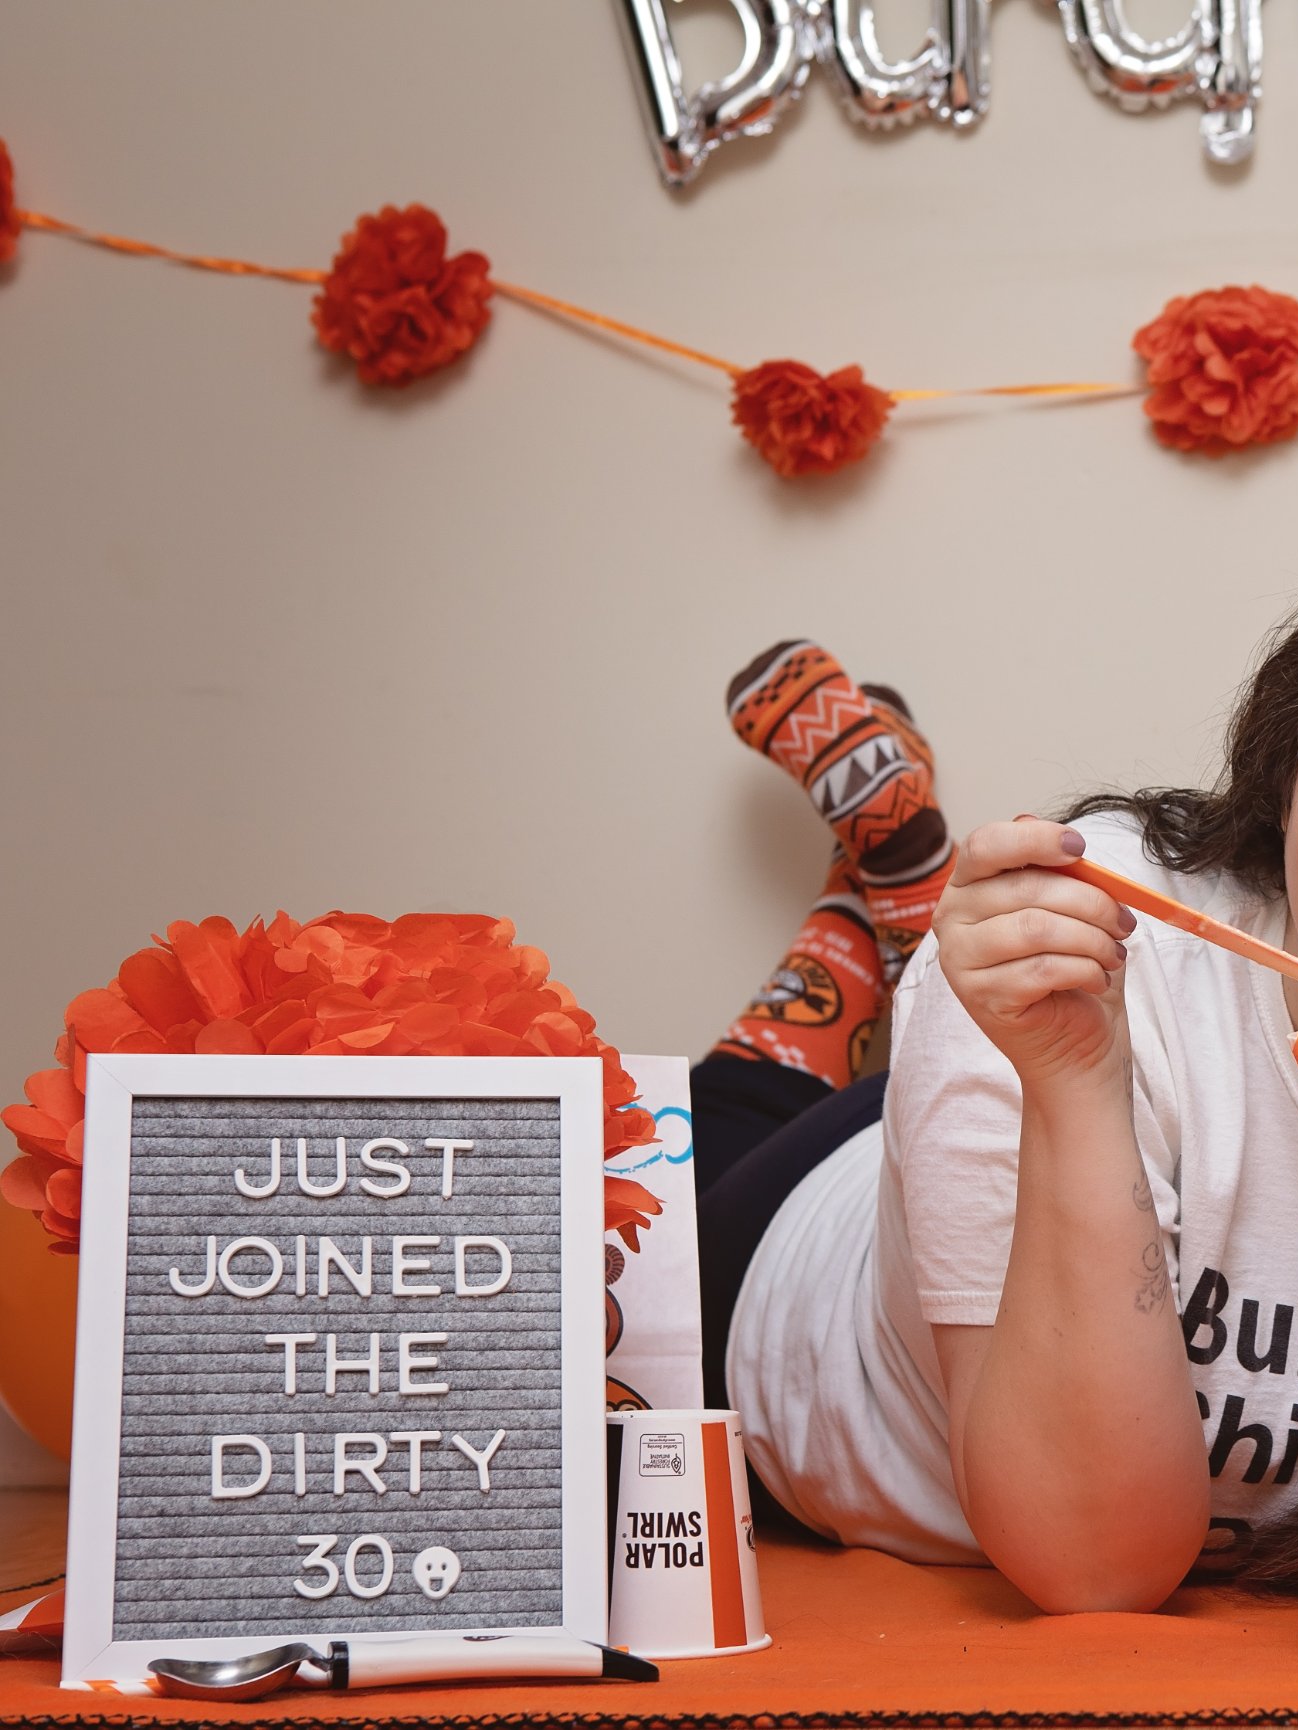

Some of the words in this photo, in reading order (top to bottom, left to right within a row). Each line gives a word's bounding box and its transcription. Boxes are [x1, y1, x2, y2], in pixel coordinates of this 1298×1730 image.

[234, 1137, 474, 1200] JUST
[169, 1234, 513, 1298] JOINED
[264, 1332, 451, 1398] THE
[211, 1428, 506, 1500] DIRTY
[293, 1533, 395, 1600] 30
[625, 1541, 704, 1569] POLAR
